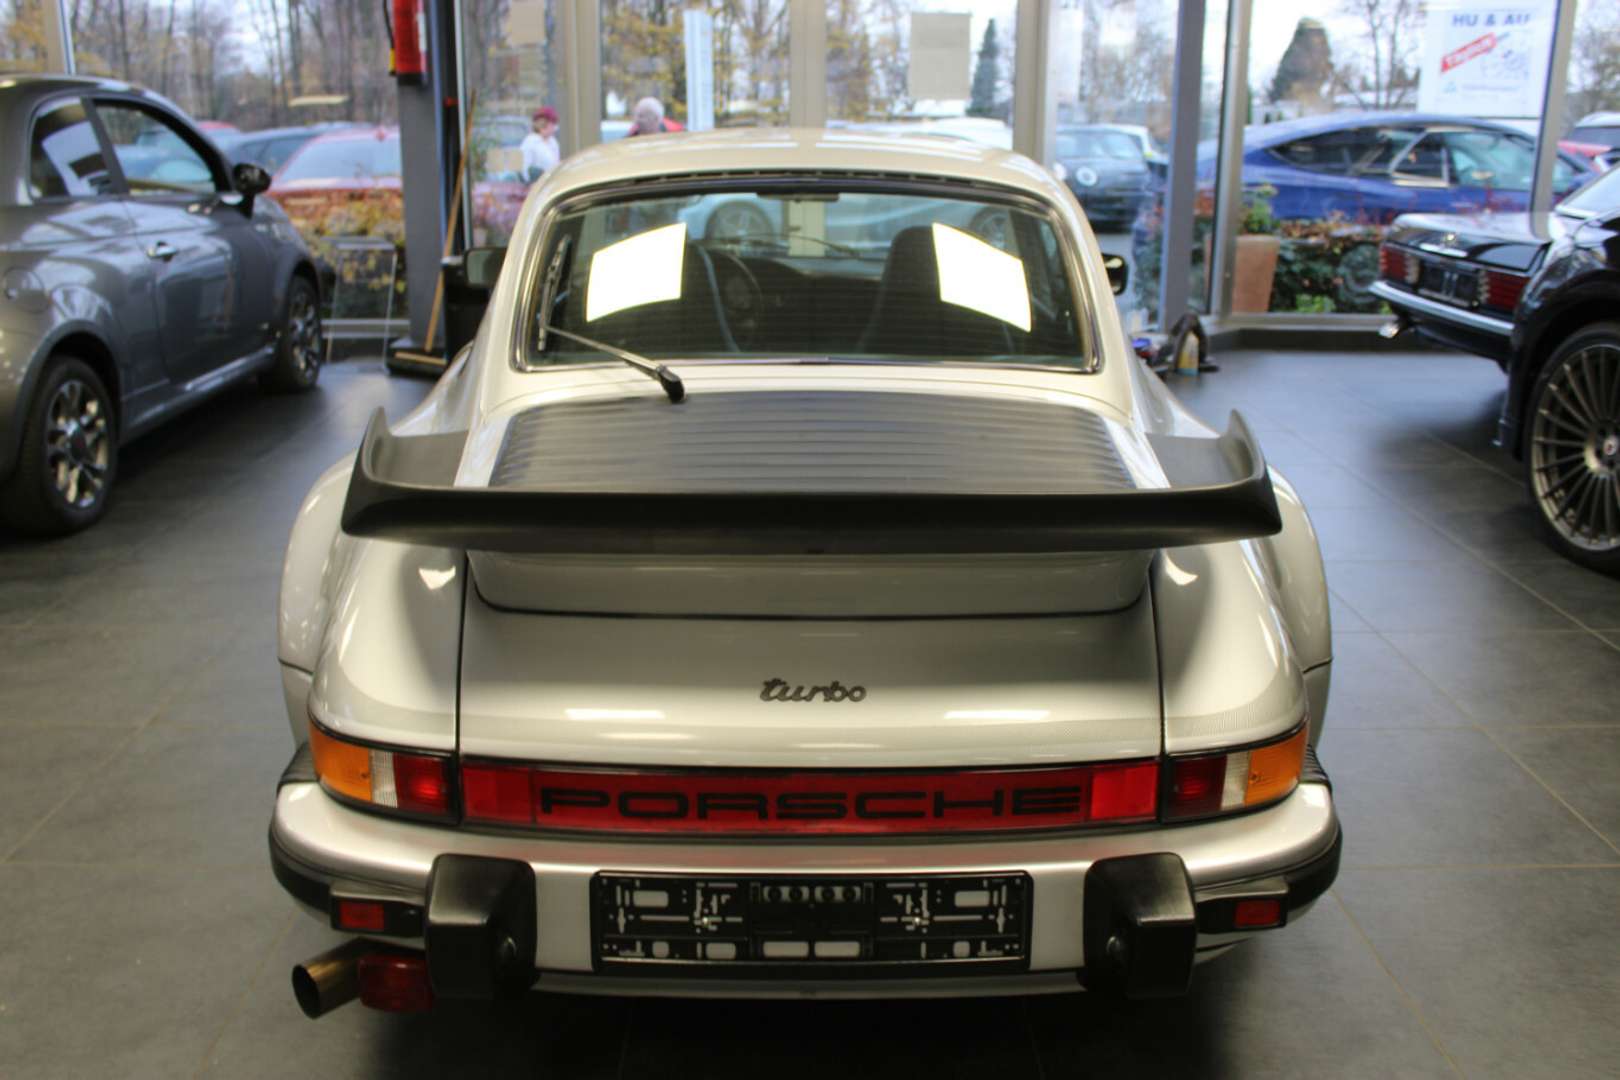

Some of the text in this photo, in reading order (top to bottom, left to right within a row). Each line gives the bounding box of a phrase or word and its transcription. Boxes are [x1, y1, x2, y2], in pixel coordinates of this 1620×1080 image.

[1452, 13, 1479, 27] HU
[1485, 13, 1496, 27] &
[760, 678, 867, 702] turbo
[541, 786, 1081, 820] PORSCHE
